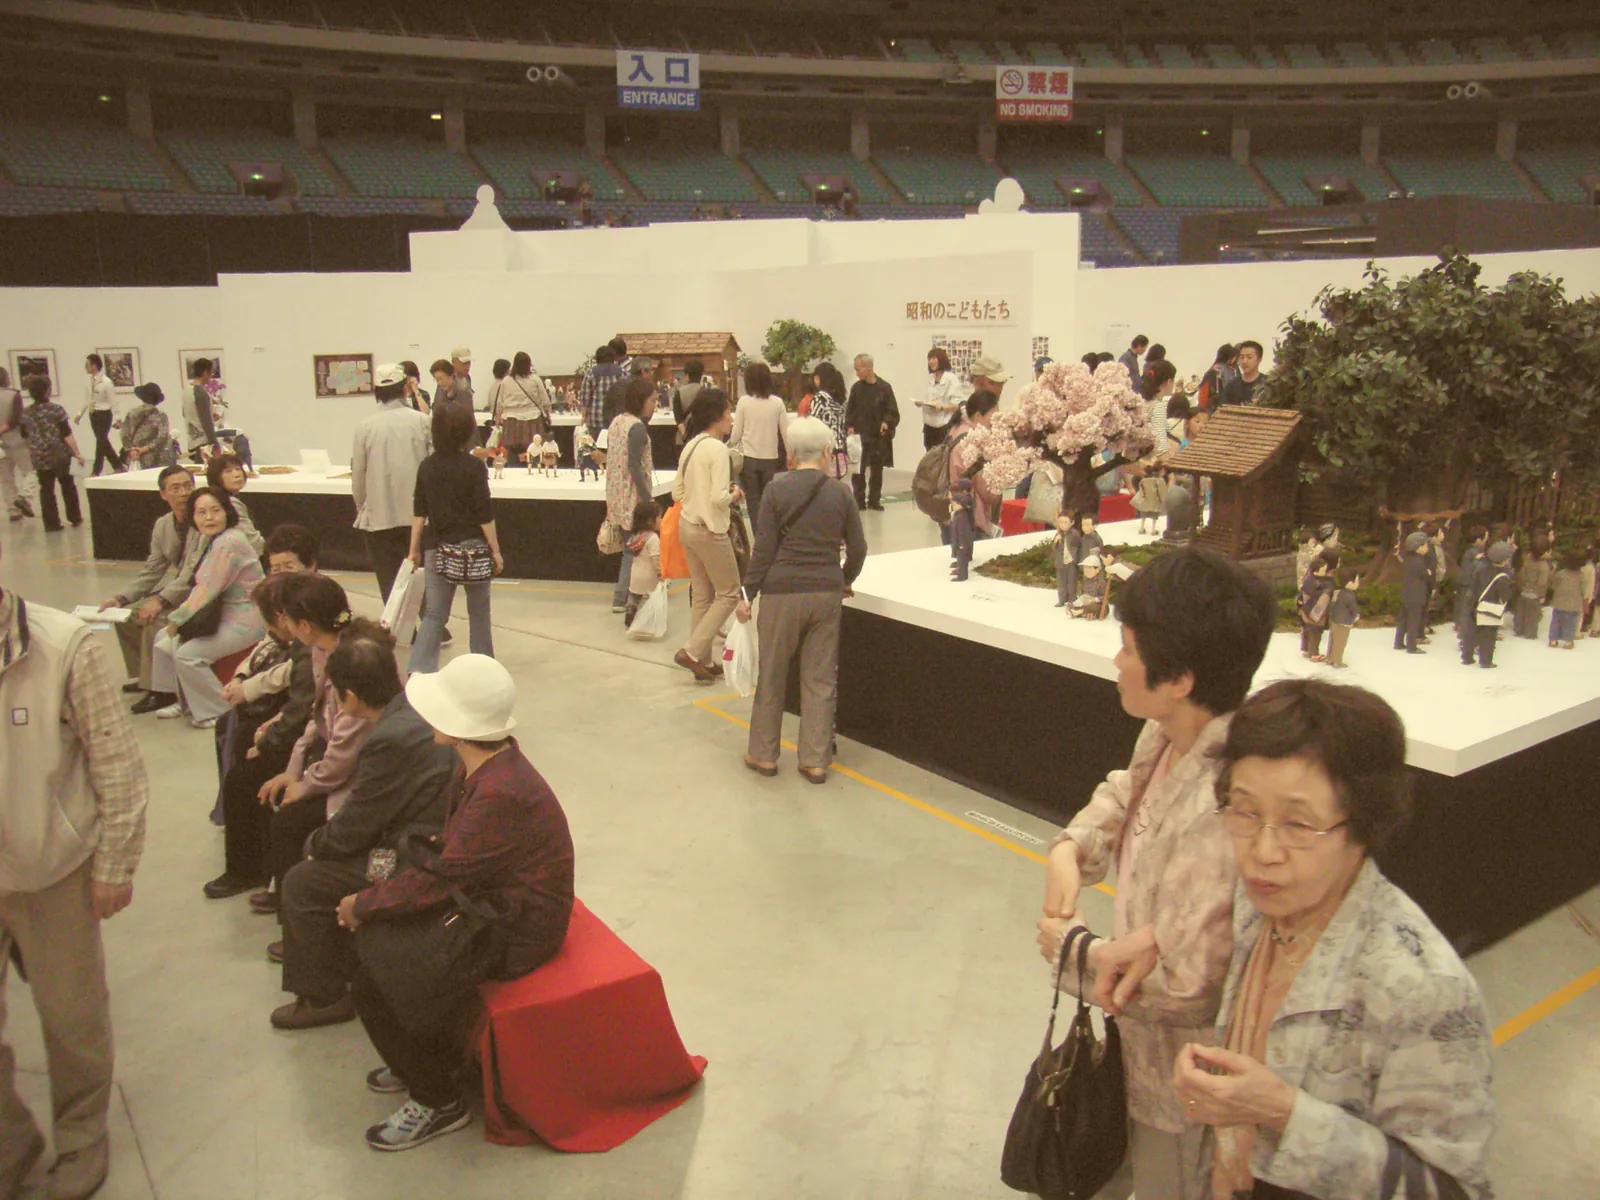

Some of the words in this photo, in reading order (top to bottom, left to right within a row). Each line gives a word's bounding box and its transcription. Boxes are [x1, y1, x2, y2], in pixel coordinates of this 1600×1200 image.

[628, 55, 689, 84] 入口
[1027, 71, 1069, 95] 禁煙
[622, 91, 696, 106] ENTRANCE
[1000, 103, 1016, 116] NO
[1018, 103, 1069, 117] SMOKING
[906, 299, 1011, 320] 昭和のこどもたち
